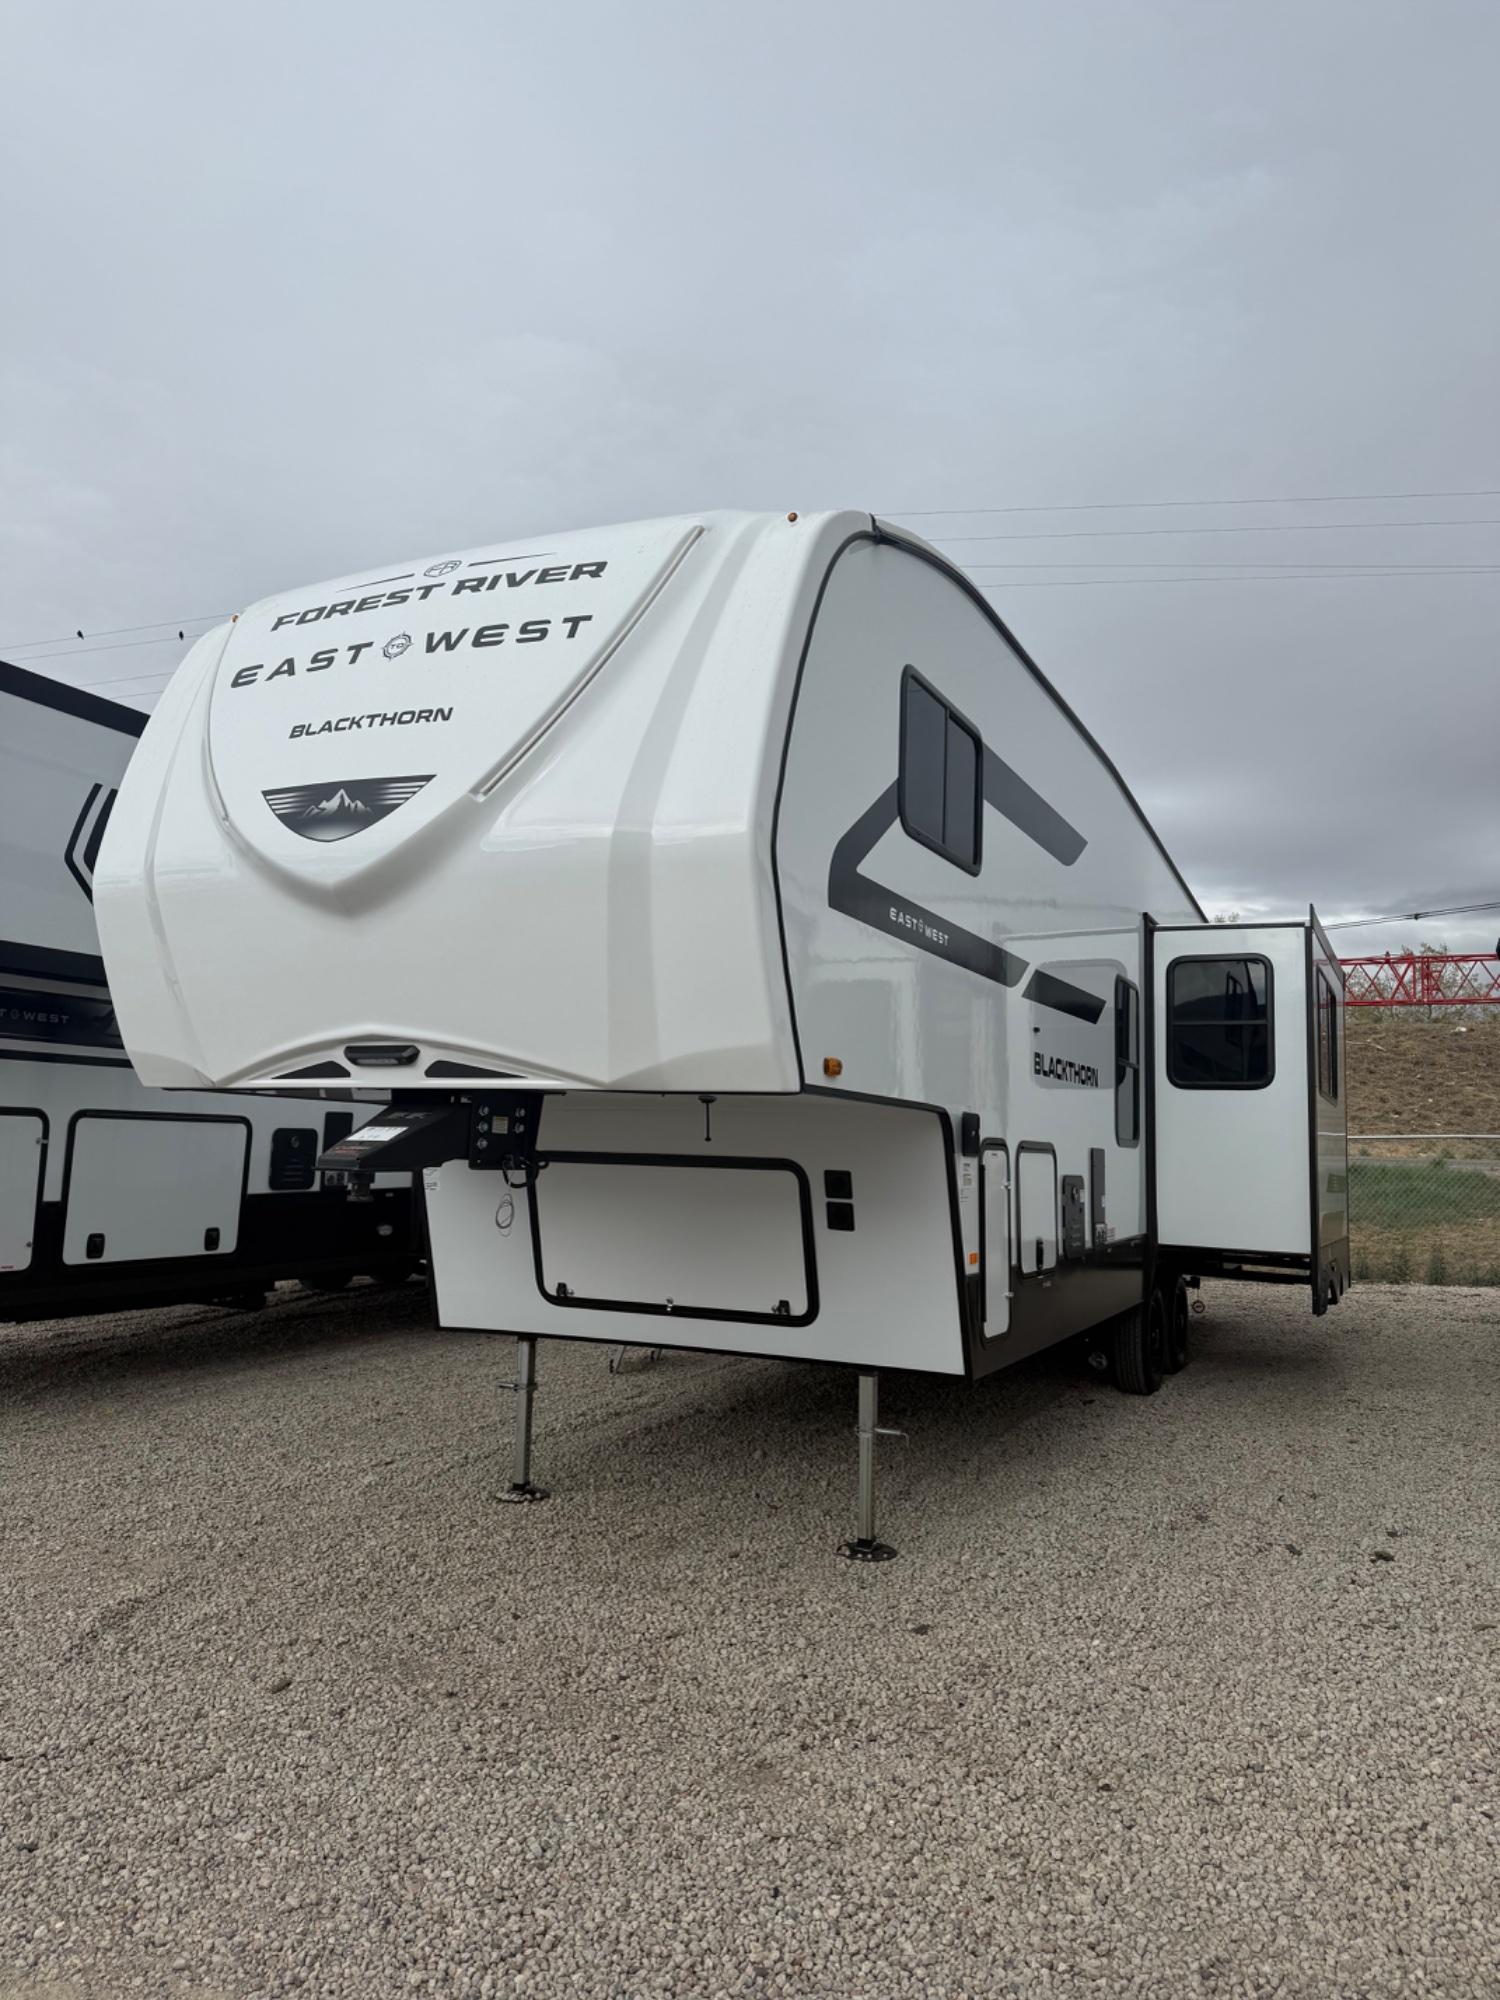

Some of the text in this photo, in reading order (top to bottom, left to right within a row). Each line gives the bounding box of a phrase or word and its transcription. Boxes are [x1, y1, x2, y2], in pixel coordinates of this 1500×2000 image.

[271, 561, 608, 632] FOREST RIVER
[230, 641, 374, 689] EAST
[425, 614, 593, 654] WEST
[288, 706, 454, 739] BLACKTHORN
[890, 906, 917, 930] EAST
[925, 925, 949, 946] WEST
[23, 1009, 70, 1024] WEST
[1034, 1051, 1099, 1088] BLACKTHORN
